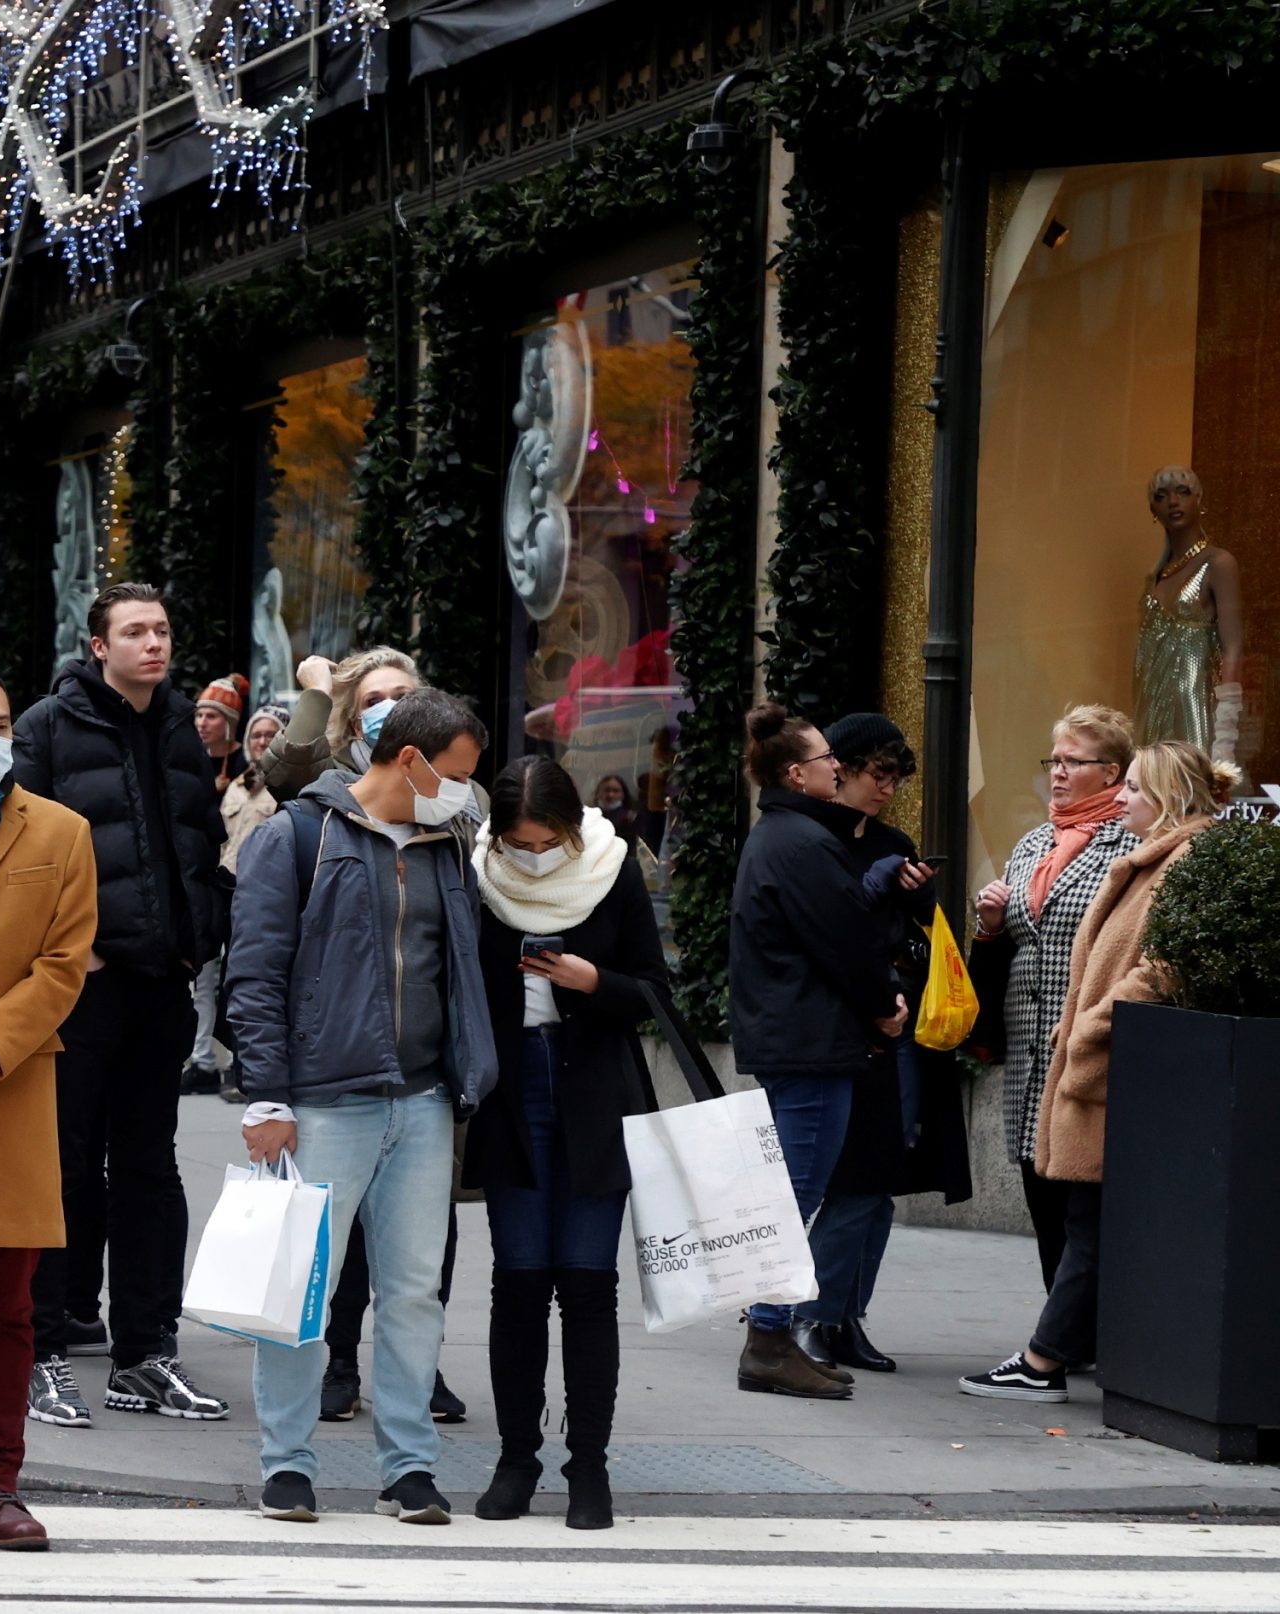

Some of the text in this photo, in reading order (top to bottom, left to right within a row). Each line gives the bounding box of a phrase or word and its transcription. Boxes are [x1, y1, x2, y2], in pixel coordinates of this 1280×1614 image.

[755, 1124, 778, 1138] NIKE
[681, 1241, 700, 1256] OF
[700, 1224, 777, 1252] INNOVATION
[641, 1258, 689, 1275] NYC/000
